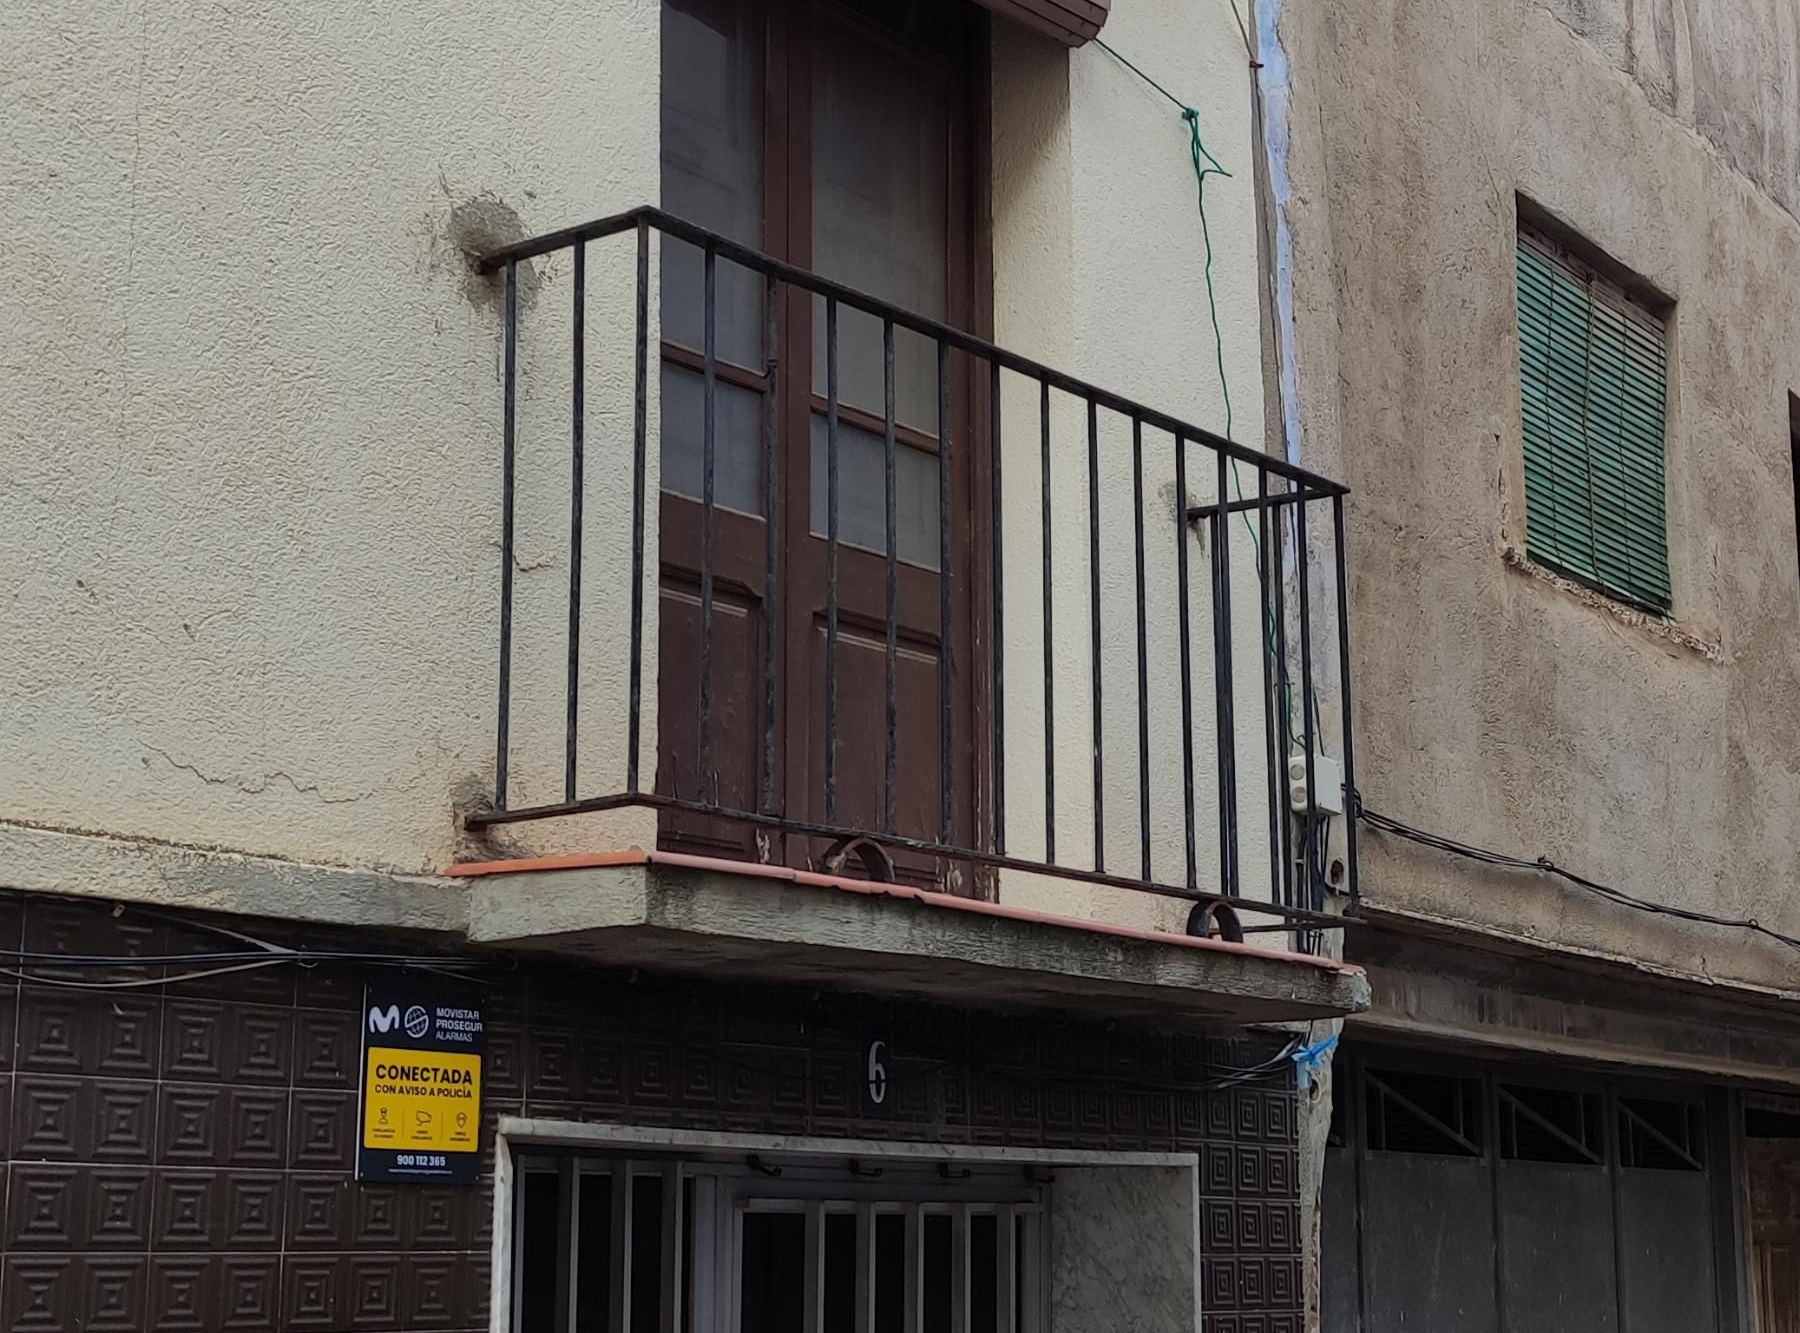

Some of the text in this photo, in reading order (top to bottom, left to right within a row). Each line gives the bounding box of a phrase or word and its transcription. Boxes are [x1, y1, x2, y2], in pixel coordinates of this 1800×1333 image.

[435, 1007, 480, 1020] MOVISTAR
[435, 1019, 483, 1032] PROSEGUR
[435, 1031, 473, 1042] ALARMAS
[375, 1064, 473, 1086] CONECTADA
[868, 1040, 886, 1104] 6
[375, 1084, 472, 1099] CON AVISO A POLICÍA
[397, 1154, 446, 1166] 900 112 365
